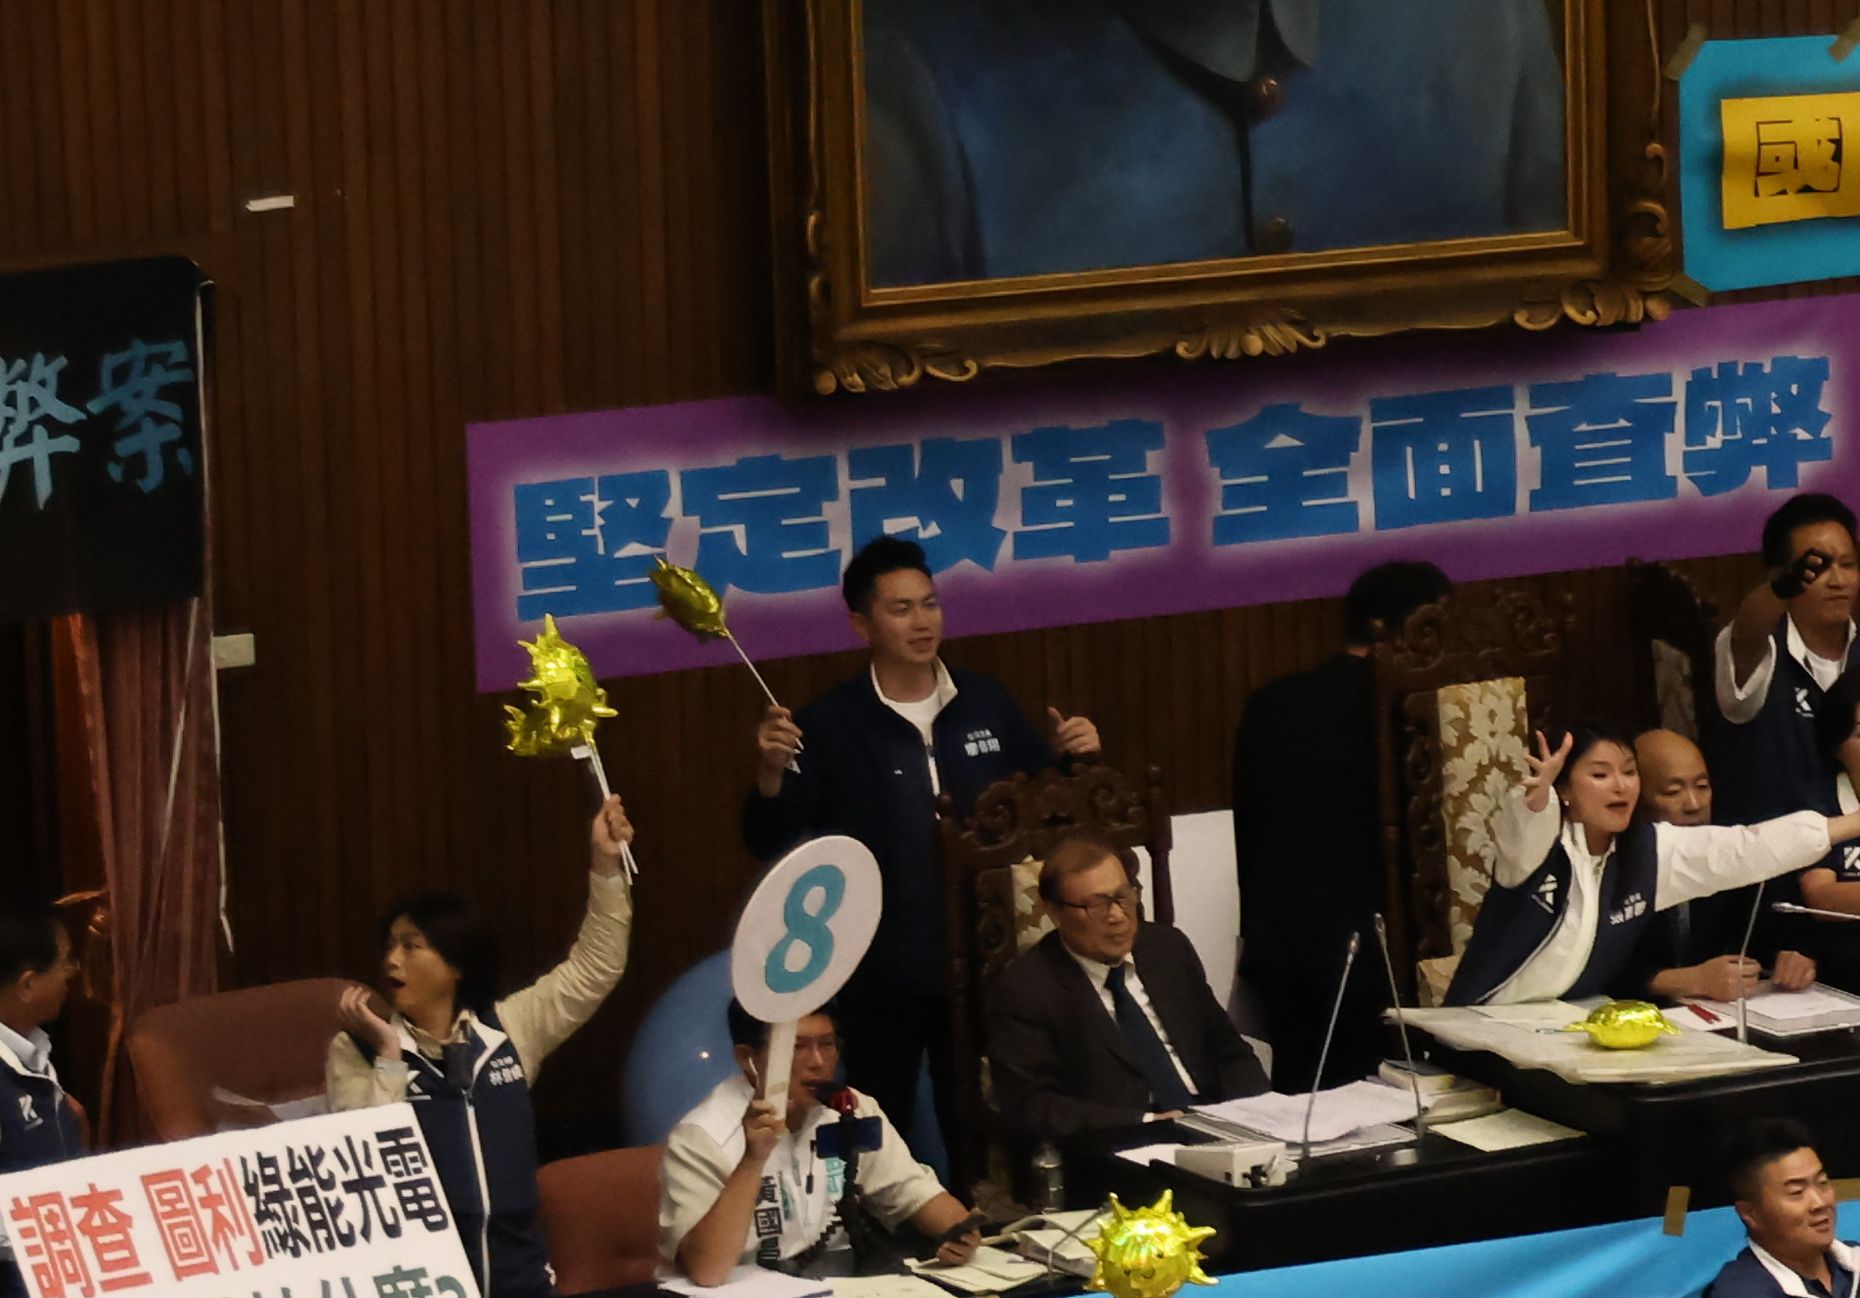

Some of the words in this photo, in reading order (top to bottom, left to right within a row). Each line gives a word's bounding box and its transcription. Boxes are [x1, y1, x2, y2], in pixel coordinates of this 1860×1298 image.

[514, 418, 1171, 621] 堅定改革
[1206, 354, 1833, 547] 全面查弊
[764, 864, 846, 994] 8
[140, 1126, 449, 1282] 圖利綠能光電
